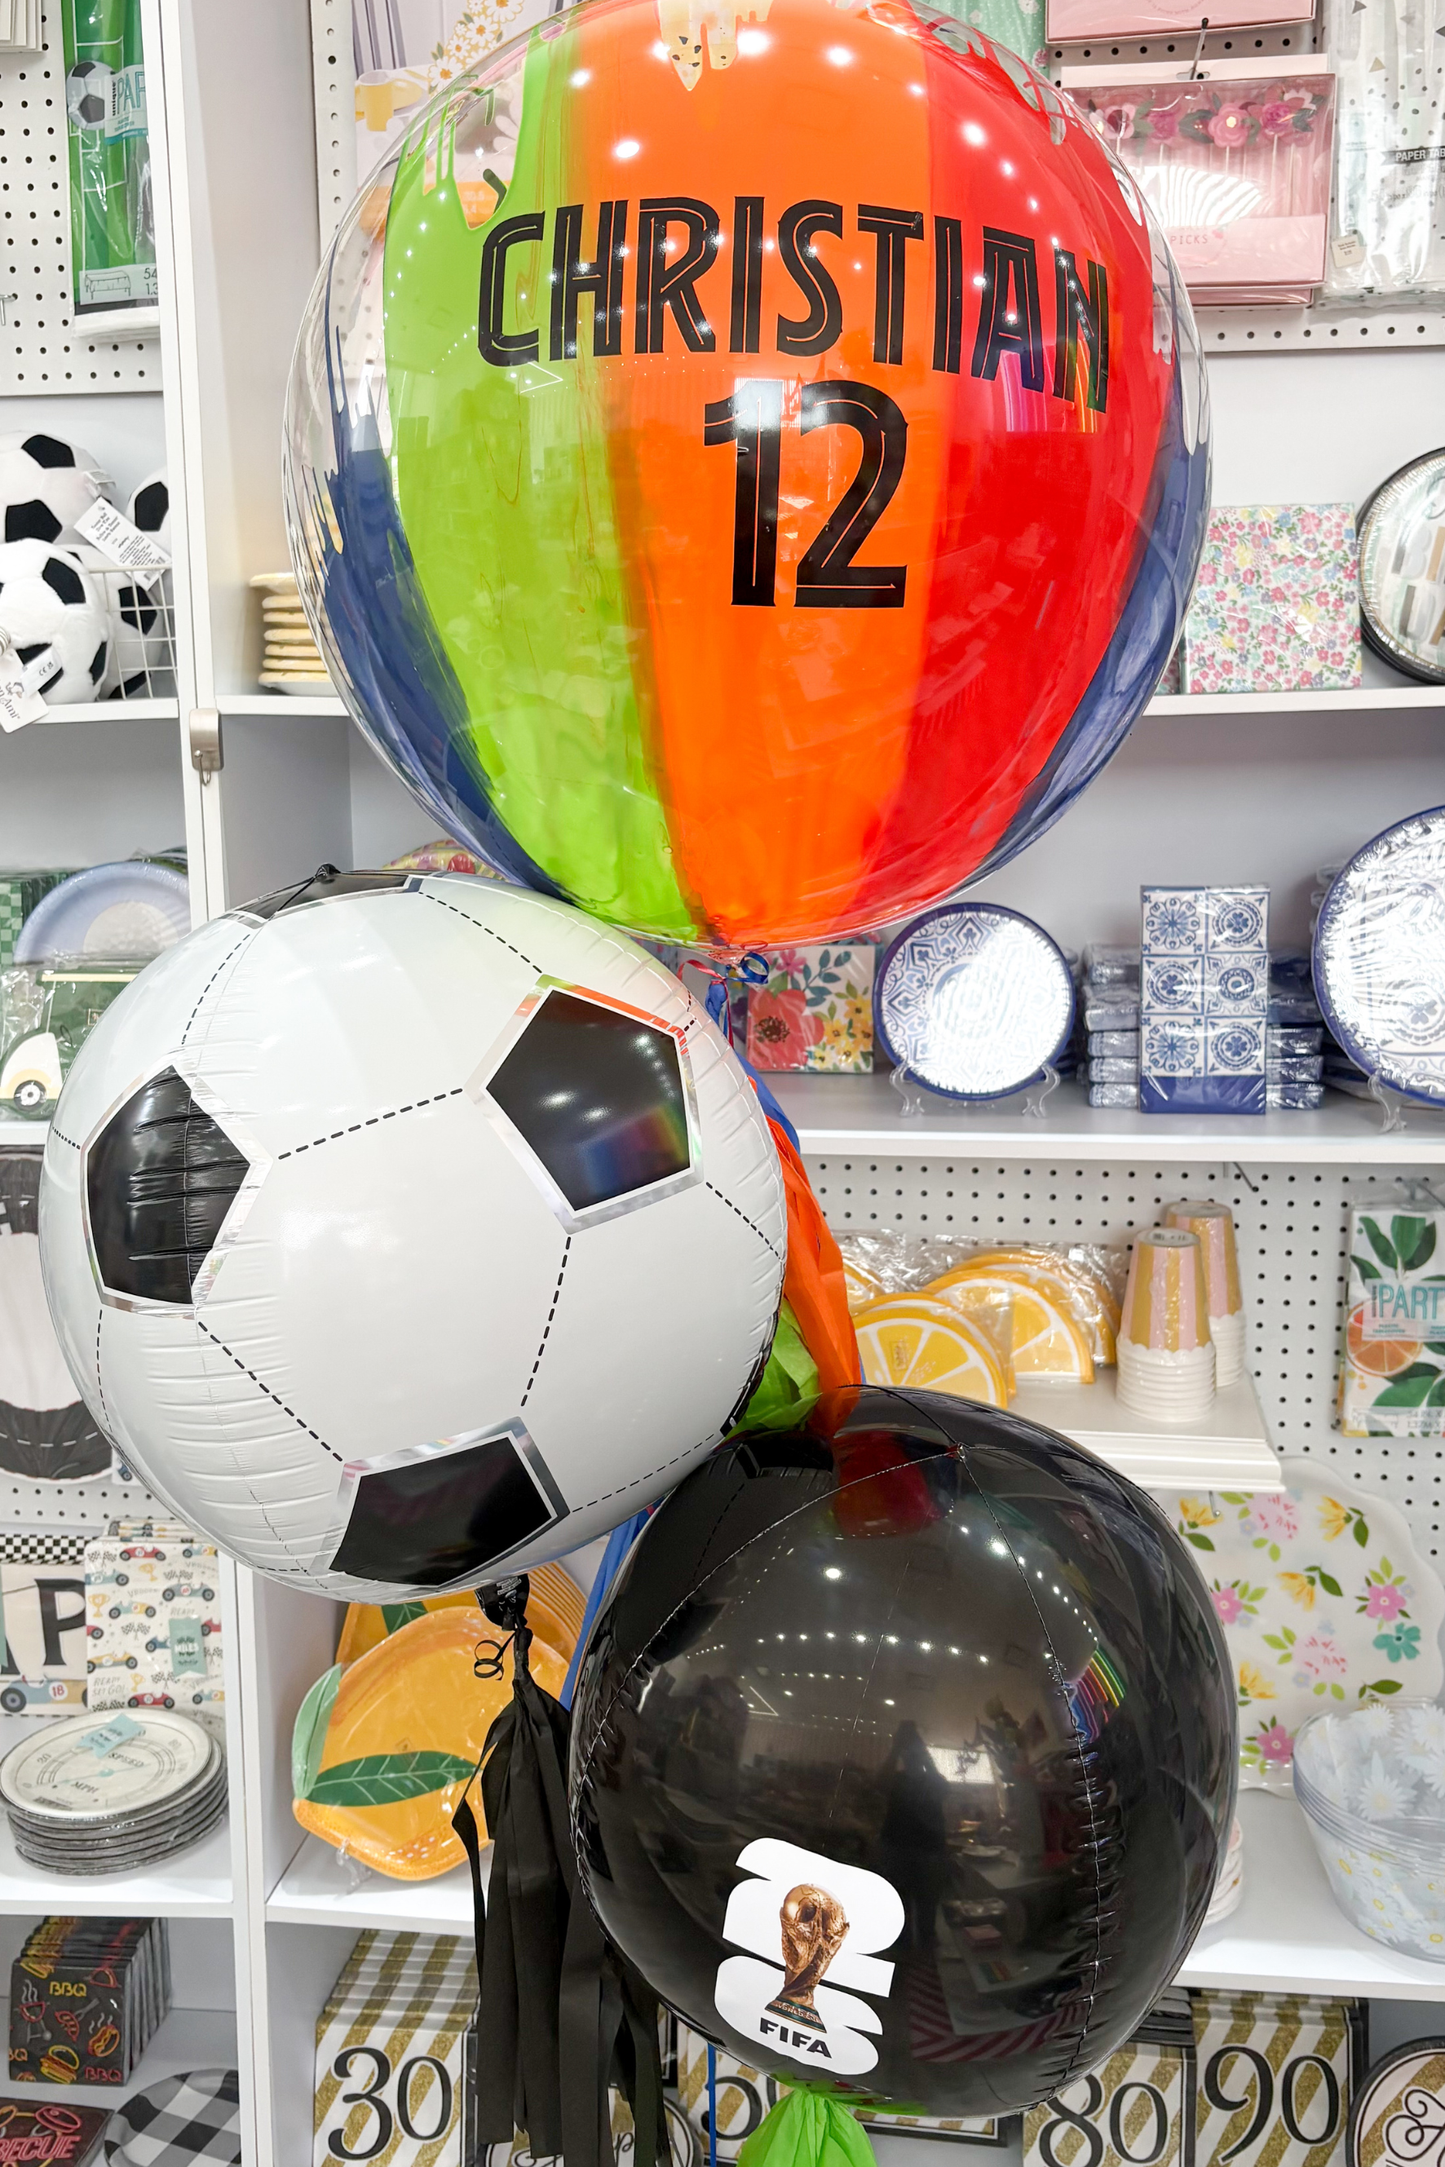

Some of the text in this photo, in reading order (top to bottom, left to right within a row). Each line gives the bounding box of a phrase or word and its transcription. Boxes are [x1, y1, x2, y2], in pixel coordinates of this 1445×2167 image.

[1395, 149, 1426, 162] PAPER
[1169, 234, 1209, 245] PICKS
[477, 196, 1109, 413] CHRISTIAN
[704, 379, 909, 608] 12
[52, 1685, 65, 1697] 18
[50, 1981, 88, 1997] BBQ
[759, 2018, 832, 2059] FIFA
[85, 2067, 123, 2082] BBQ
[328, 2046, 454, 2162] 30
[1038, 2073, 1169, 2167] 80
[1203, 2045, 1342, 2164] 90
